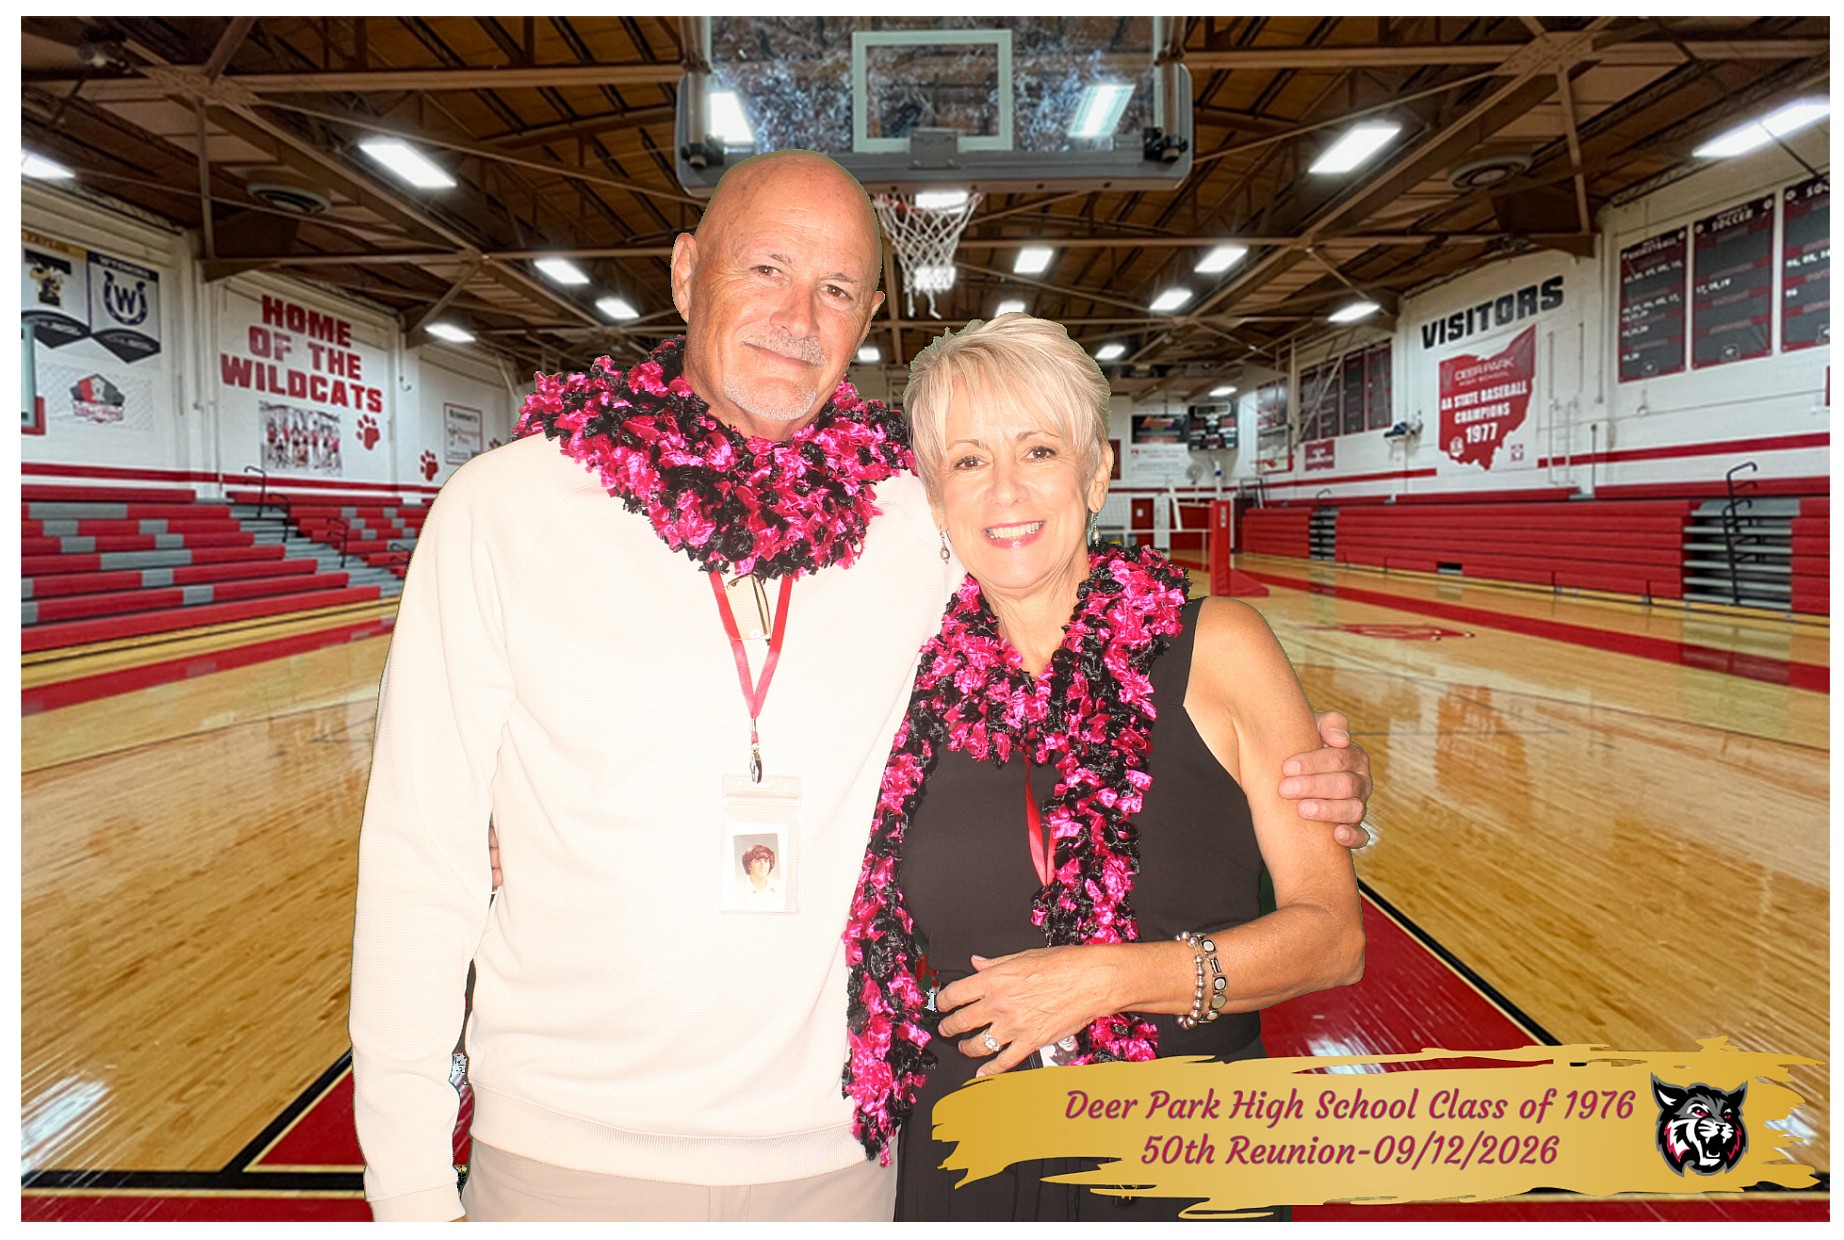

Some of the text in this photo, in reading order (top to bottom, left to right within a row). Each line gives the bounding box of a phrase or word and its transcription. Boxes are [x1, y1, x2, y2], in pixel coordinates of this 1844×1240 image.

[114, 284, 137, 315] W
[1422, 275, 1564, 350] VISITORS
[262, 294, 352, 349] HOME
[248, 325, 362, 381] OF THE
[1483, 356, 1515, 372] PARK
[220, 353, 383, 413] WILDCATS
[1441, 380, 1528, 410] AA STATE BASEBALL
[1454, 402, 1511, 424] CHAMPIONS
[1465, 422, 1498, 444] 1977
